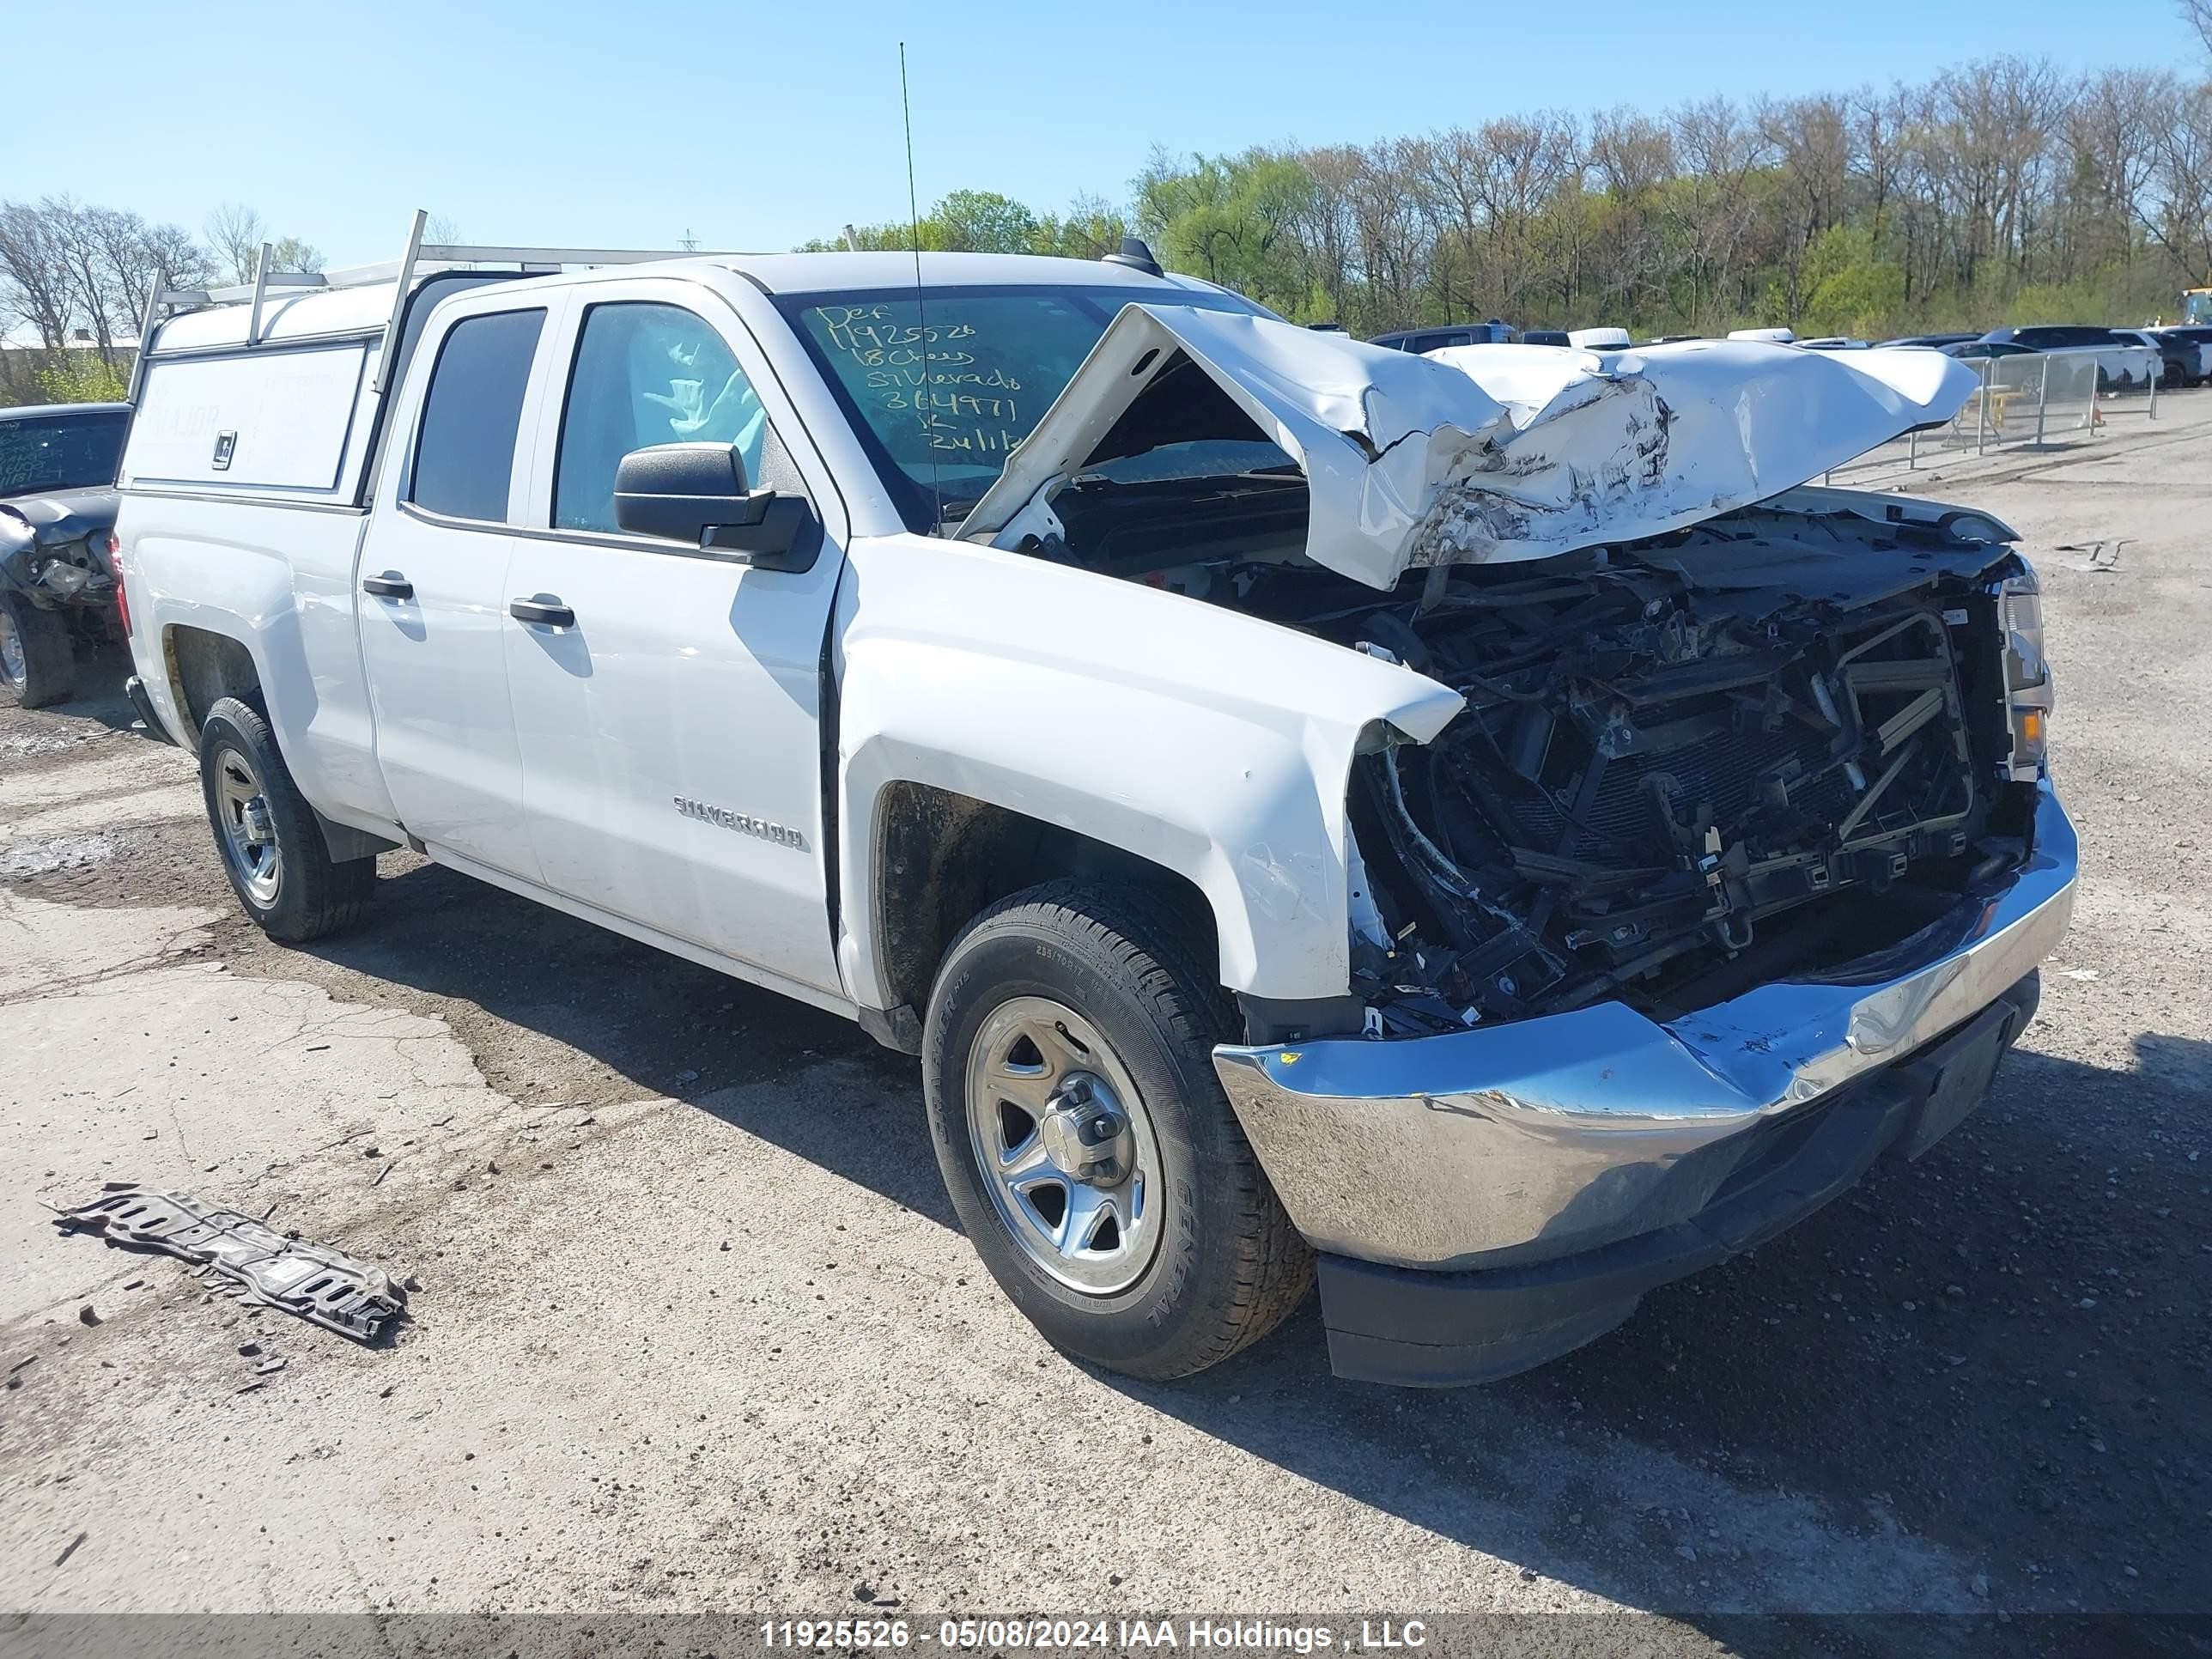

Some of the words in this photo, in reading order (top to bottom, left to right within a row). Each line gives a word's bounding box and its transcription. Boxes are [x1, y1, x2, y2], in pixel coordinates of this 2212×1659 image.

[828, 324, 976, 350] 11925526
[673, 794, 803, 847] SILVERADO
[1146, 1177, 1197, 1328] GENERAL
